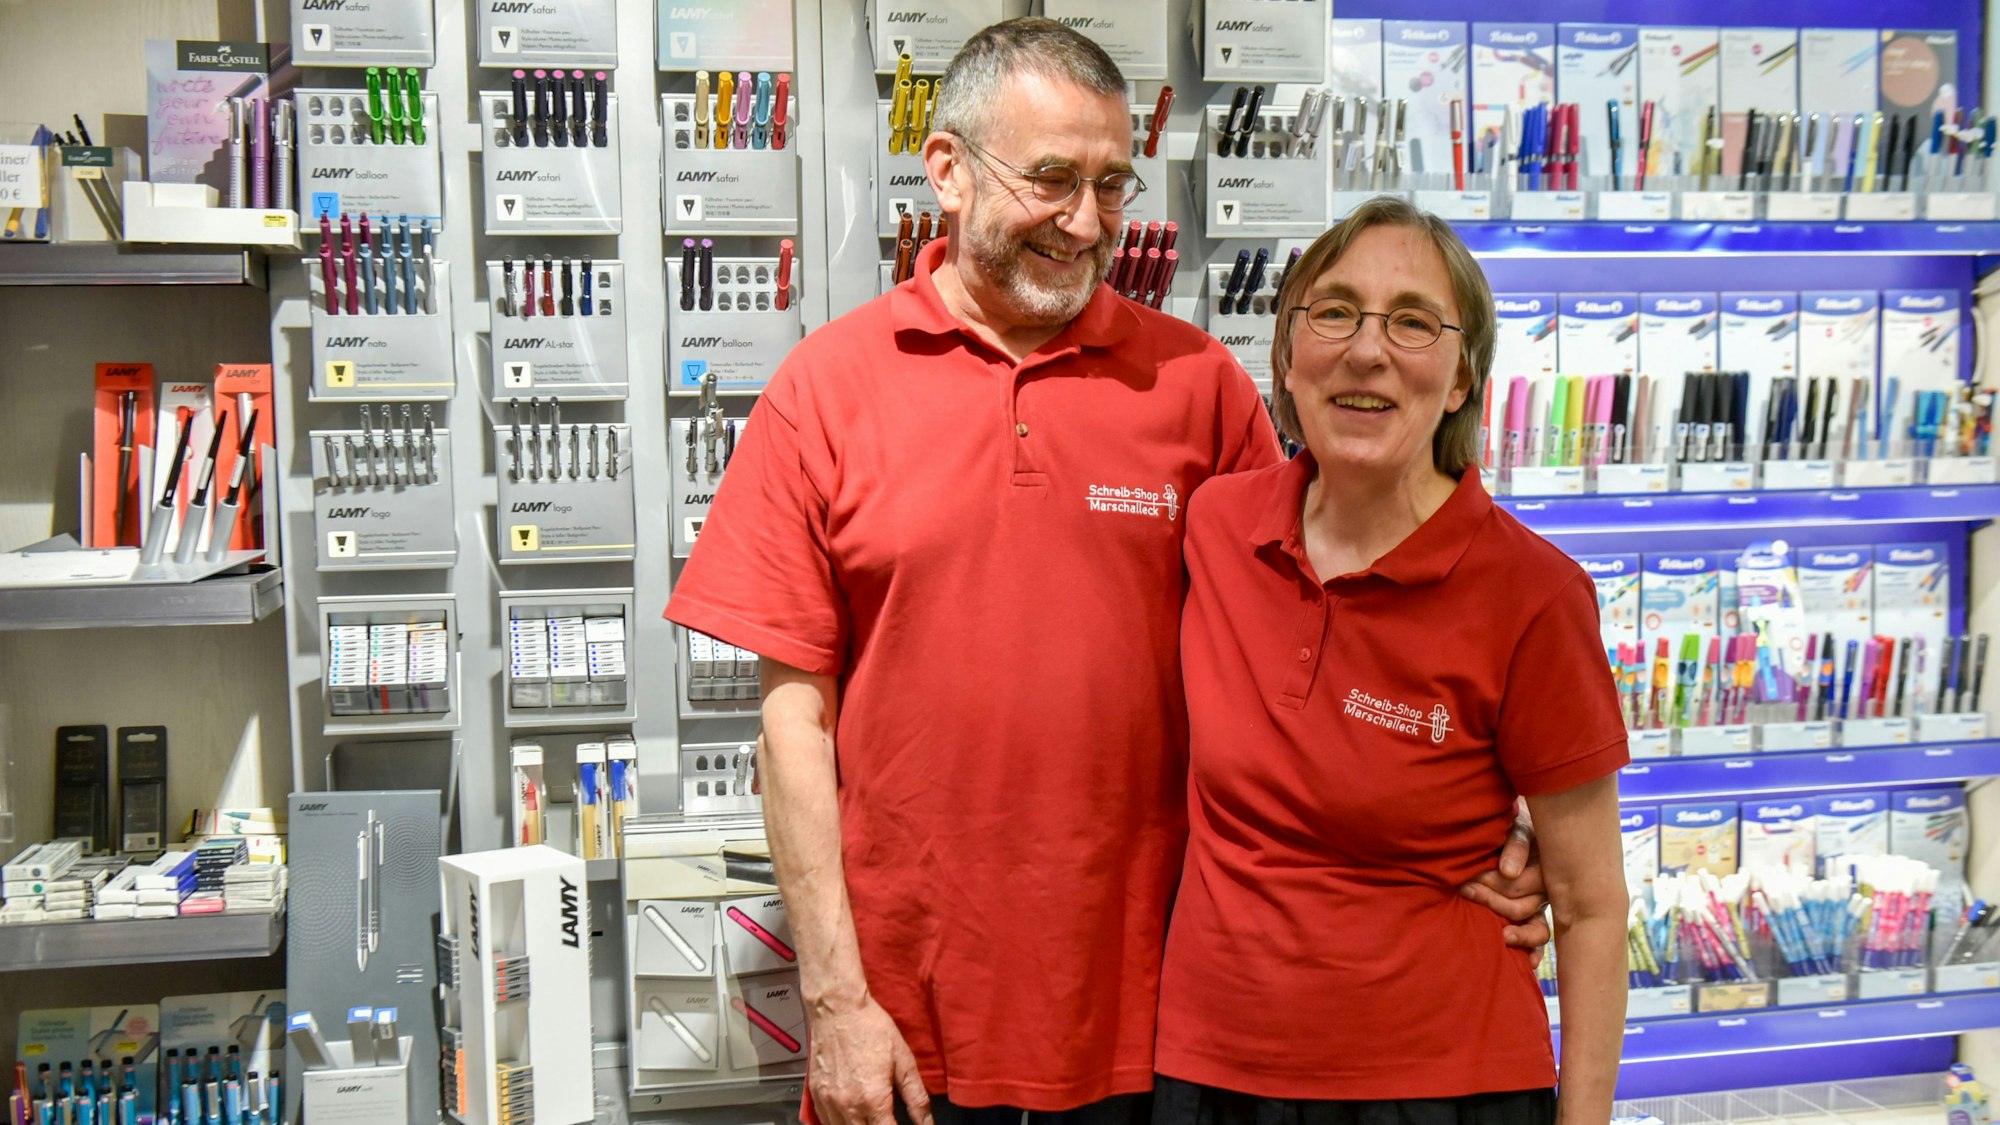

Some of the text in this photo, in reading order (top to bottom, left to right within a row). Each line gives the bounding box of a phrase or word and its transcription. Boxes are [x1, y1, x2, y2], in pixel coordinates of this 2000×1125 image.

[302, 0, 370, 12] LAMY safari
[491, 2, 557, 15] LAMY safari
[669, 8, 711, 20] LAMY
[887, 12, 949, 24] LAMY safari
[1093, 19, 1115, 29] safari
[1216, 20, 1274, 33] LAMY safari
[311, 167, 389, 180] LAMY balloon
[496, 170, 561, 182] LAMY safari
[676, 171, 740, 183] LAMY safari
[889, 175, 928, 186] LAMY
[1217, 178, 1274, 189] LAMY safari
[13, 191, 22, 200] €
[326, 336, 368, 348] LAMY
[504, 338, 574, 349] LAMY AL-star
[681, 337, 753, 348] LAMY balloon
[105, 367, 141, 376] LAMY
[226, 369, 260, 378] LAMY
[171, 385, 207, 393] LAMY
[684, 494, 715, 505] LAM
[1089, 484, 1159, 505] Schreib-Shop
[327, 507, 391, 520] LAMY logo
[511, 501, 573, 514] LAMY logo
[1089, 500, 1159, 517] Marschalleck
[1349, 688, 1423, 722] Schreib-Shop
[1343, 702, 1419, 736] Marschalleck
[299, 803, 329, 812] LAMY
[559, 874, 579, 949] LAMY
[469, 882, 480, 961] LAMY
[766, 989, 790, 999] LAMY
[337, 1085, 362, 1094] LAMY
